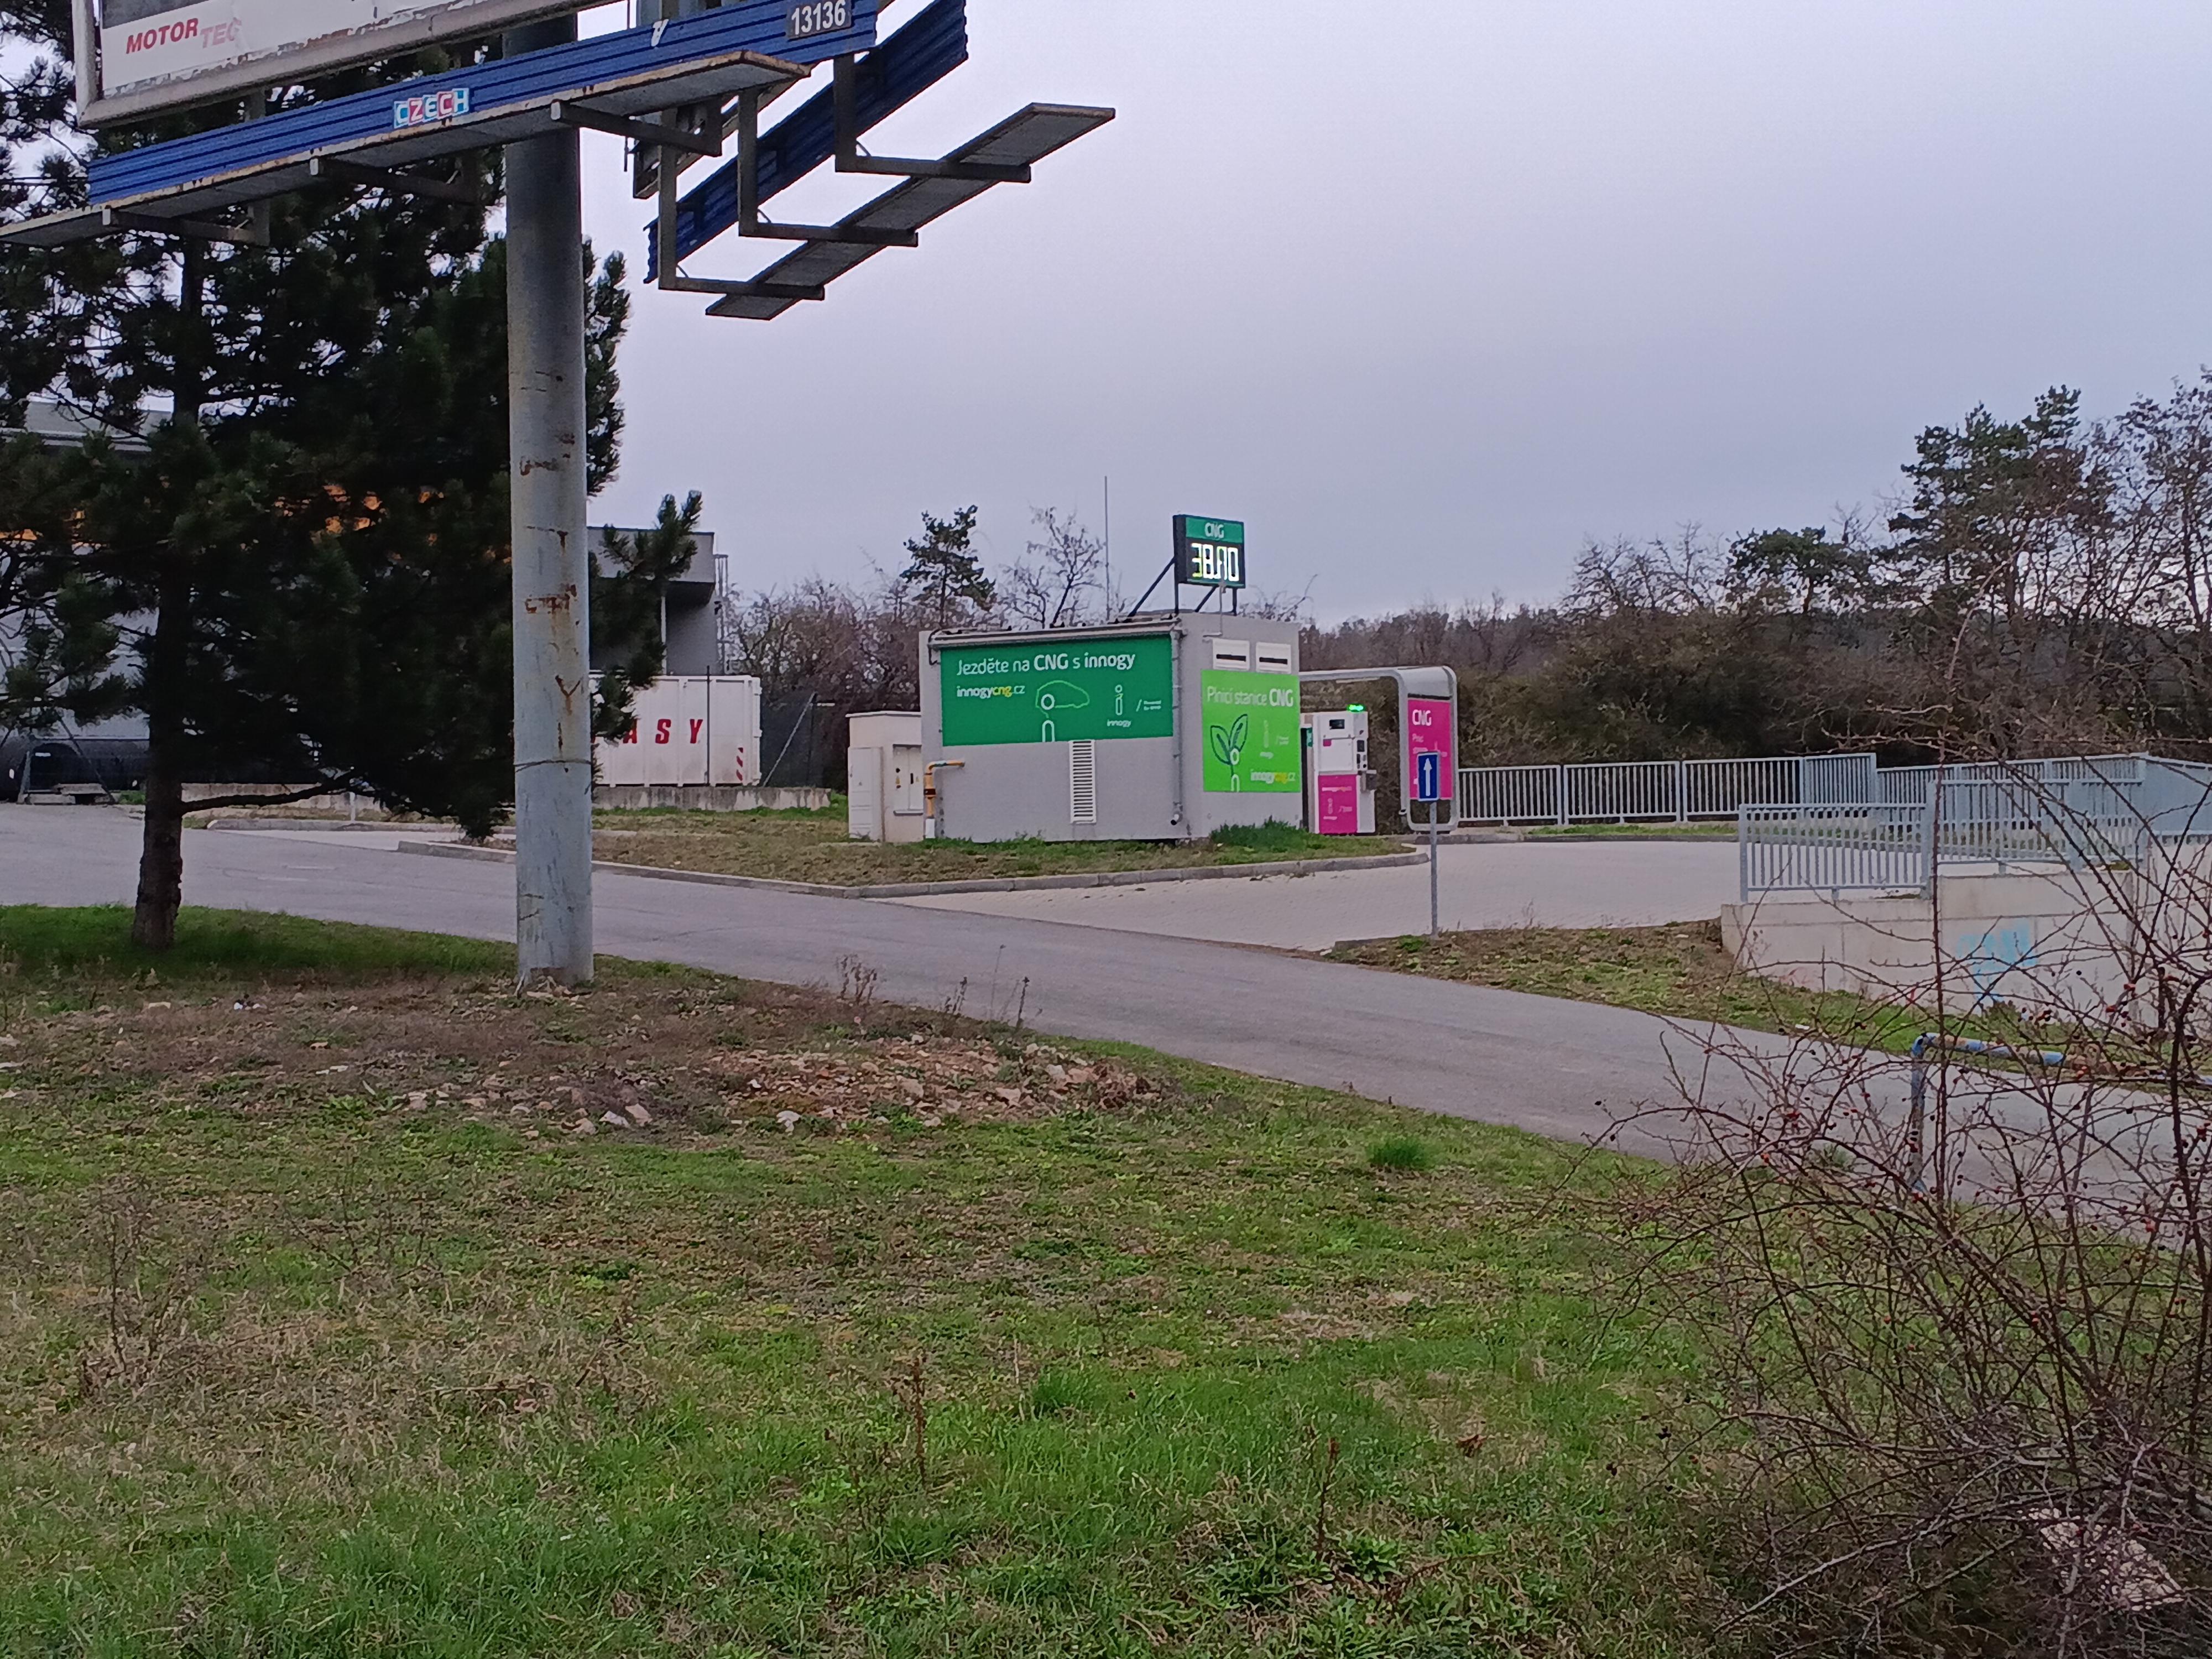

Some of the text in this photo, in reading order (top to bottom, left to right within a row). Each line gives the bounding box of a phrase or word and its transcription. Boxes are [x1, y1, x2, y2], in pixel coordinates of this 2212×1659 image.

[791, 0, 846, 35] 13136
[126, 18, 199, 54] MOTOR
[395, 88, 469, 126] CZECH
[1205, 522, 1224, 539] CNG
[957, 652, 1136, 675] Jezděte na CNG s innogy
[1269, 688, 1294, 707] CNG
[1412, 709, 1432, 727] CNG
